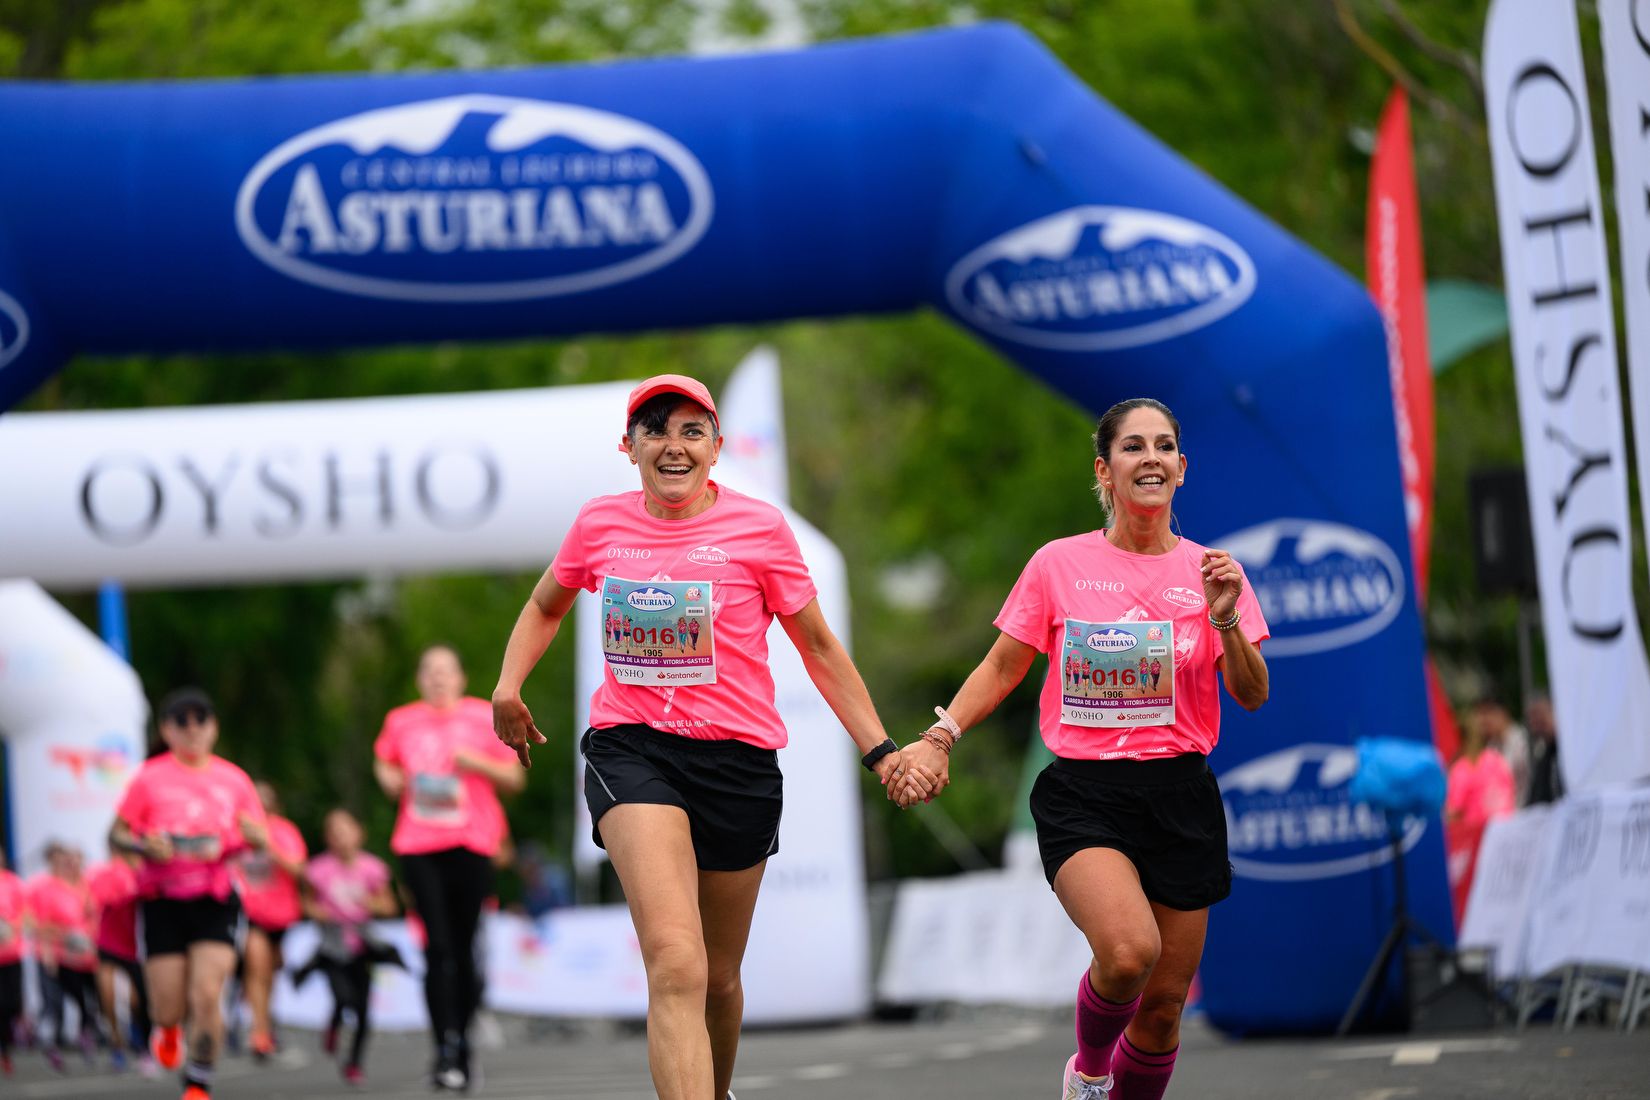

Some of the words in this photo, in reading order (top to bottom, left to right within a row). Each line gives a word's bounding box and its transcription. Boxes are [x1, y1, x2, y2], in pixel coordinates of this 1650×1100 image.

[277, 161, 676, 254] ASTURIANA
[1505, 60, 1625, 643] OYSHO
[79, 440, 502, 545] OYSHO
[607, 548, 651, 560] OYSHO
[690, 552, 727, 563] ASTURIANA
[1075, 579, 1125, 593] OYSHO
[630, 594, 673, 606] ASTURIANA
[1166, 590, 1201, 606] ASTURIANA
[632, 627, 675, 645] 016
[1090, 637, 1135, 647] ASTURIANA
[606, 653, 626, 662] CARRERA
[663, 657, 710, 665] VITORIA-GASTEIZ
[643, 649, 663, 657] 1905
[612, 667, 644, 678] OYSHO
[666, 671, 702, 680] Santander
[1091, 668, 1137, 686] 016
[1102, 690, 1124, 698] 1906
[1064, 696, 1084, 705] CARRERA
[1123, 698, 1170, 706] VITORIA-GASTEIZ
[1071, 710, 1104, 721] OYSHO
[1126, 712, 1162, 721] Santander
